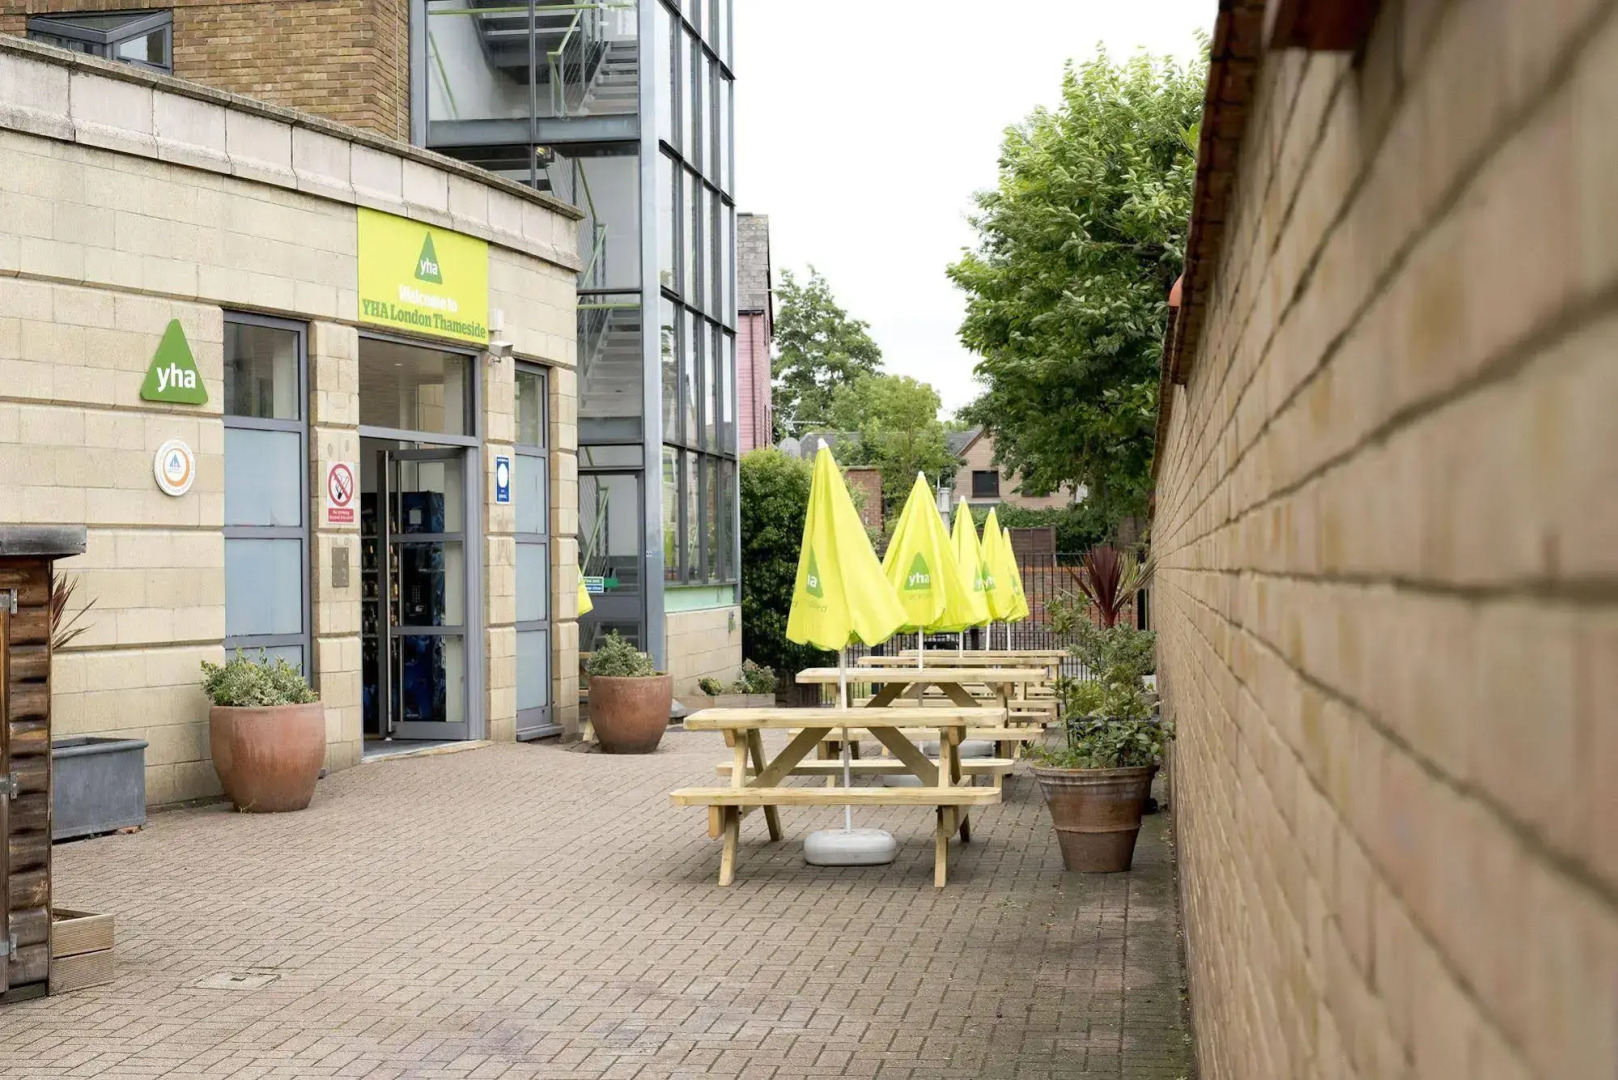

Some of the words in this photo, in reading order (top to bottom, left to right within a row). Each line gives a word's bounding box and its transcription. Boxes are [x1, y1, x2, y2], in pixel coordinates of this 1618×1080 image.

[420, 258, 438, 275] yha
[399, 284, 446, 310] Welcome
[446, 297, 458, 312] to
[362, 298, 389, 319] YHA
[390, 304, 432, 328] London
[432, 313, 486, 339] Thameside
[156, 362, 196, 393] yha
[909, 572, 930, 587] yha
